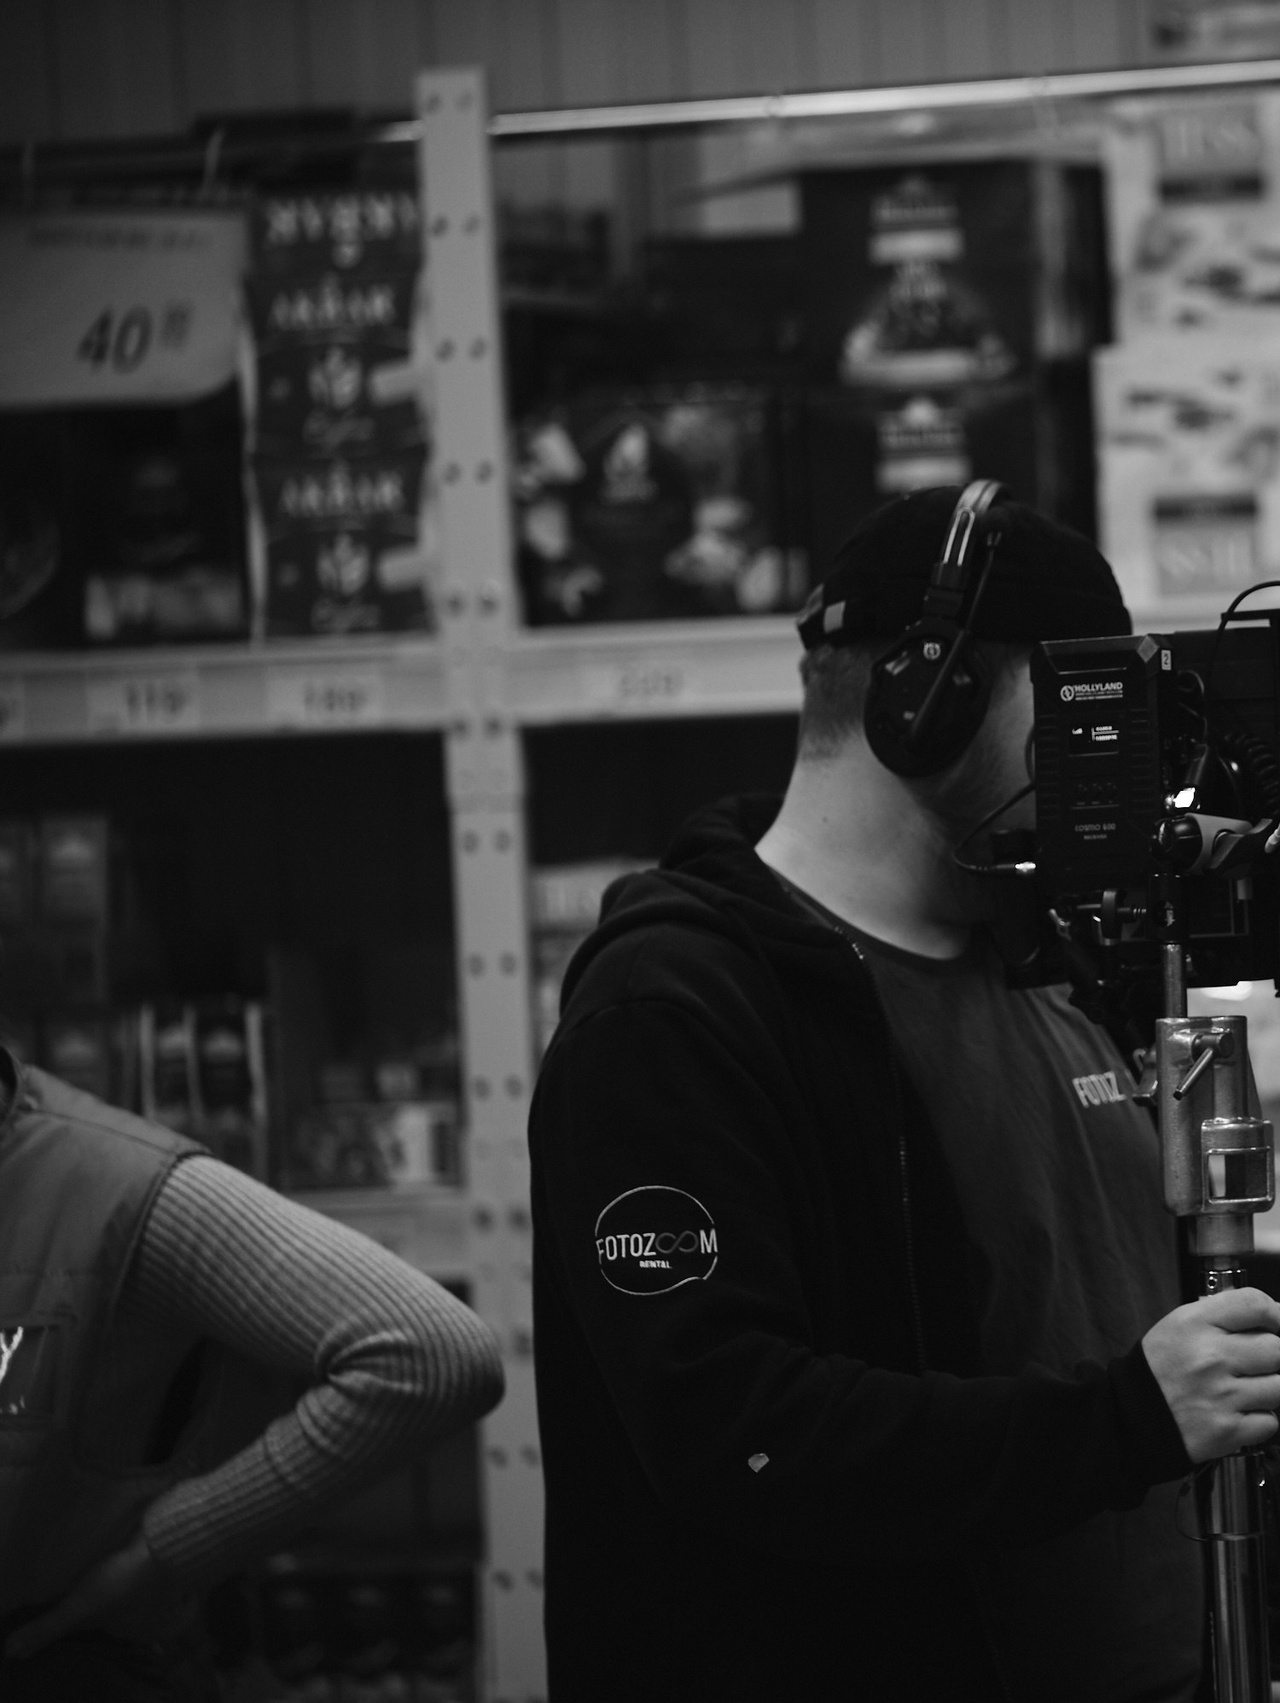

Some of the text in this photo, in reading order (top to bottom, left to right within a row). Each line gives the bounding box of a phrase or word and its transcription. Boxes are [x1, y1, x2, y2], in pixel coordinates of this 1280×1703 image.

[77, 303, 154, 376] 40
[1074, 682, 1123, 692] HOLLYLAND
[639, 1260, 673, 1269] RENTAL
